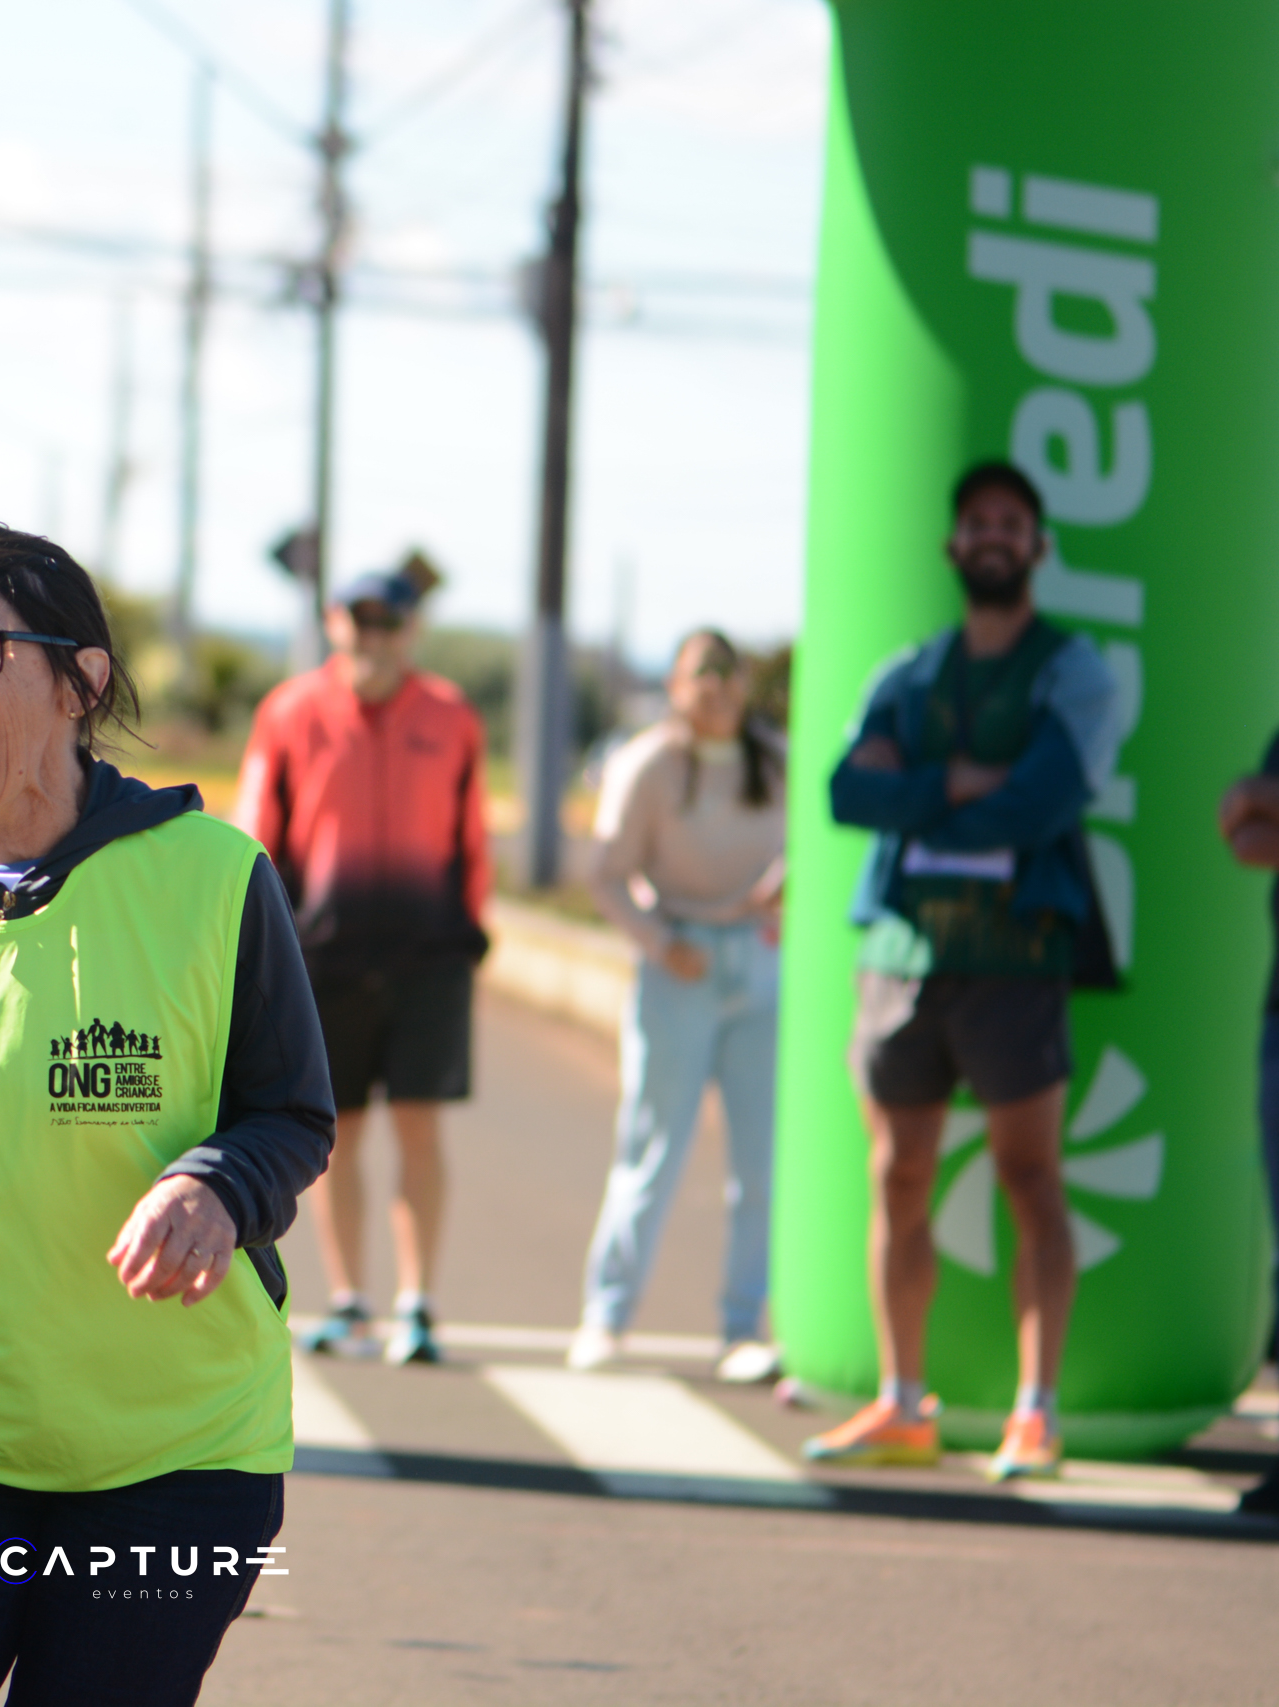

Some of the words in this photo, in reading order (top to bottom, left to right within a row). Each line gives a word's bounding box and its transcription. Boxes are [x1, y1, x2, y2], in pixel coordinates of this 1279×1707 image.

[114, 1063, 146, 1074] ENTRE
[48, 1062, 111, 1099] ONG
[115, 1086, 163, 1099] CRIANÇAS
[50, 1102, 56, 1113] A
[56, 1102, 77, 1113] VIDA
[77, 1102, 97, 1113] FICA
[97, 1102, 121, 1113] MAIS
[121, 1102, 161, 1113] DIVERTIDA
